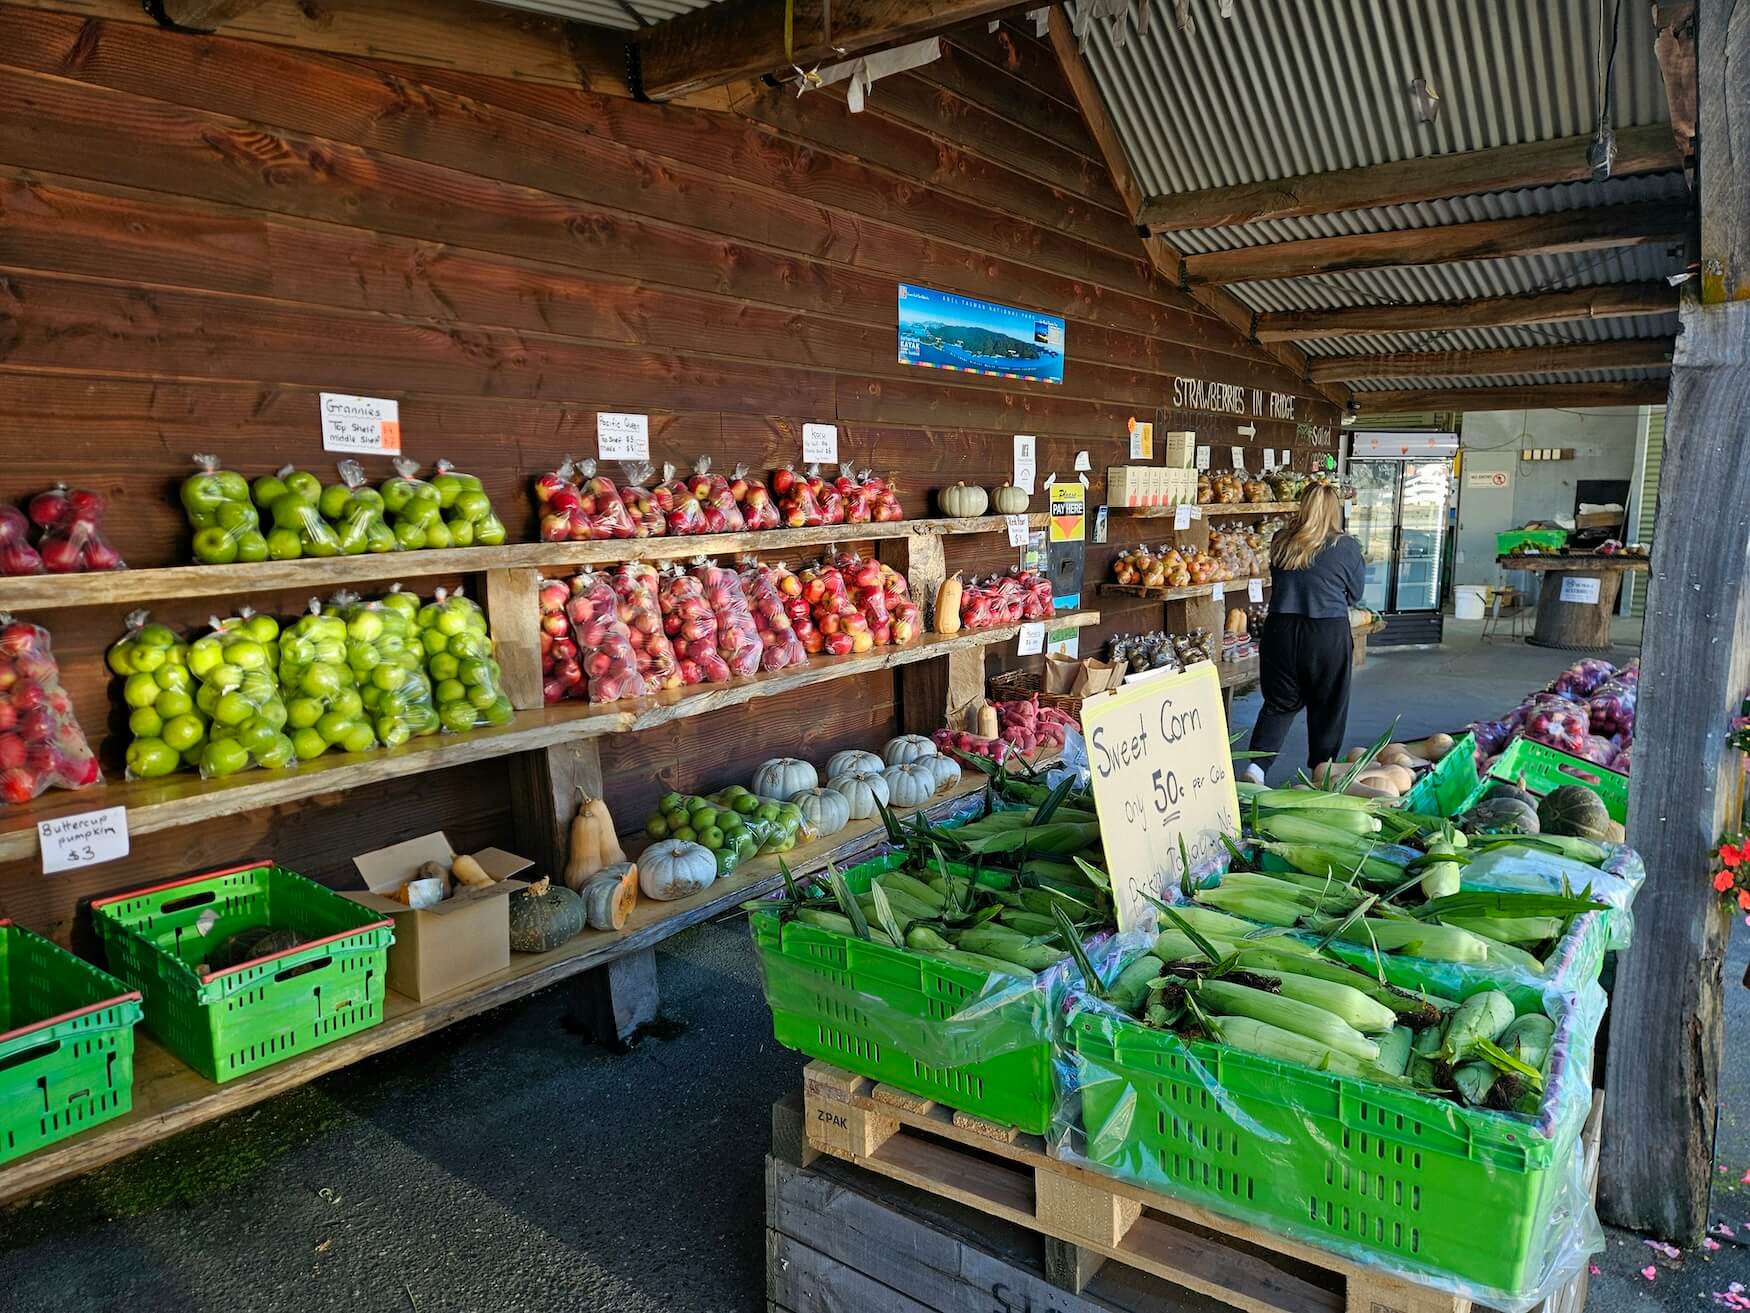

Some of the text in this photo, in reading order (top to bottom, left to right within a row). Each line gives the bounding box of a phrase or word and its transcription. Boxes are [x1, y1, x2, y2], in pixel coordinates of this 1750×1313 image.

[942, 295, 958, 305] ABEL
[961, 299, 986, 310] TASMAN
[989, 305, 1018, 317] NATIONAL
[326, 399, 381, 417] Grannies
[1173, 376, 1296, 420] STRAWBERRIES IN FRIDGE
[1053, 502, 1083, 515] PAY HERE
[1092, 699, 1202, 778] Sweet Corn
[1192, 776, 1206, 801] per
[42, 815, 108, 837] Buttercup
[58, 827, 116, 848] pumpkin
[67, 846, 96, 862] $3
[817, 1109, 848, 1130] ZPAK
